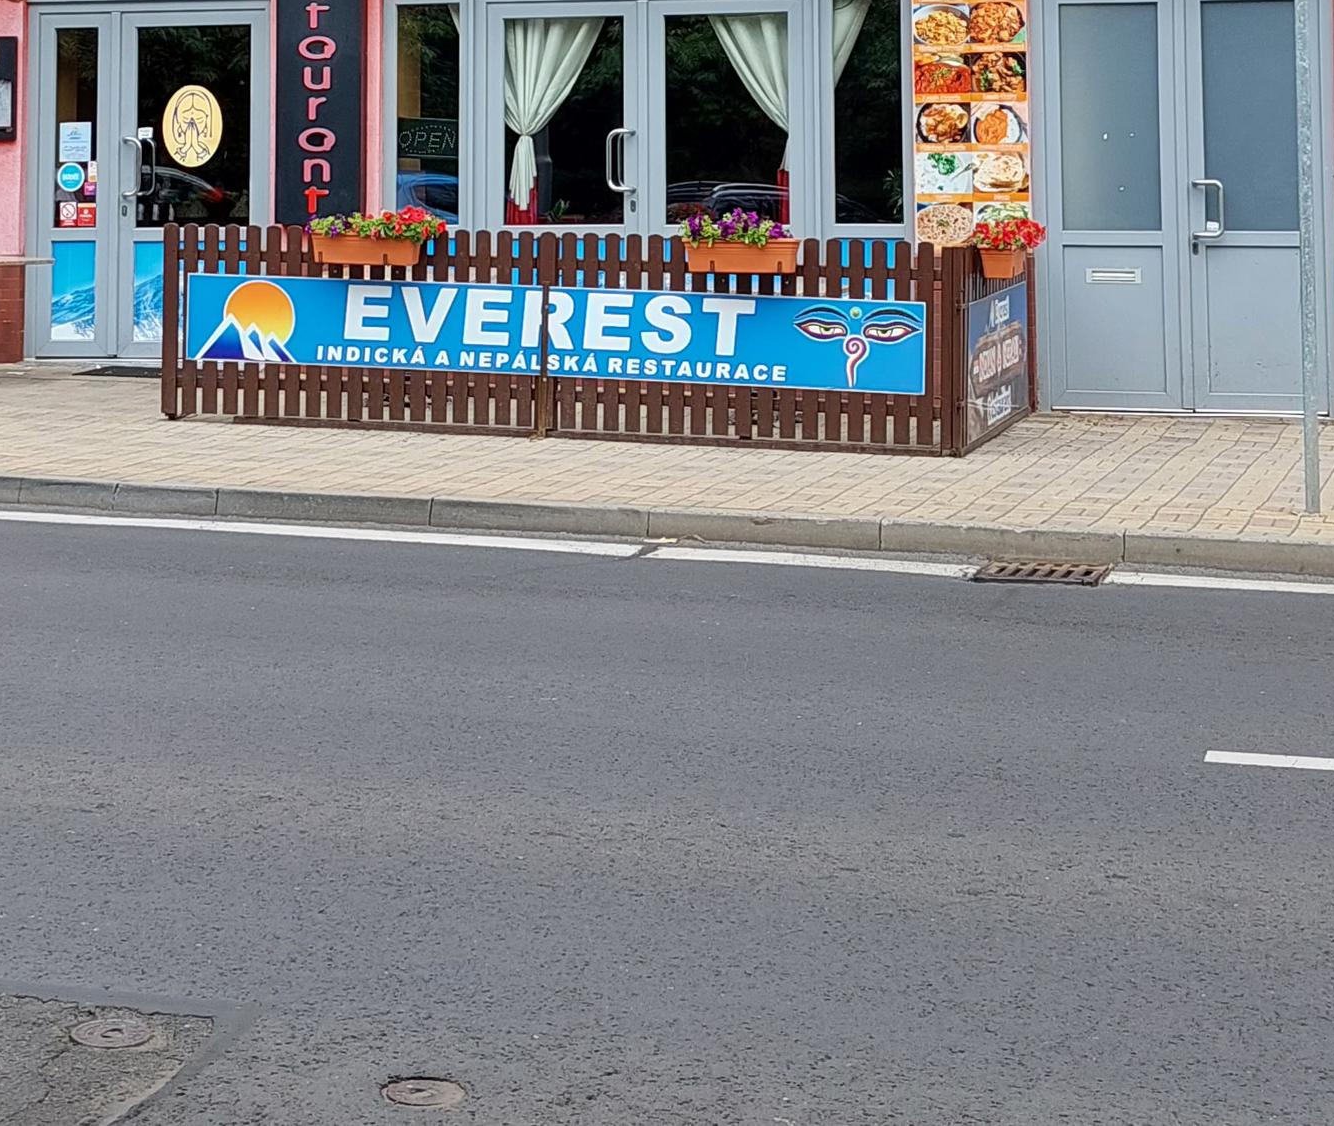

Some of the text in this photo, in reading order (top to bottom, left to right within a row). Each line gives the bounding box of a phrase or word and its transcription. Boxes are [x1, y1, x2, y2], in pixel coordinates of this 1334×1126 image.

[344, 284, 756, 357] EVEREST
[316, 344, 788, 382] INDICKÁ A NEPÁLSKÁ RESTAURACE
